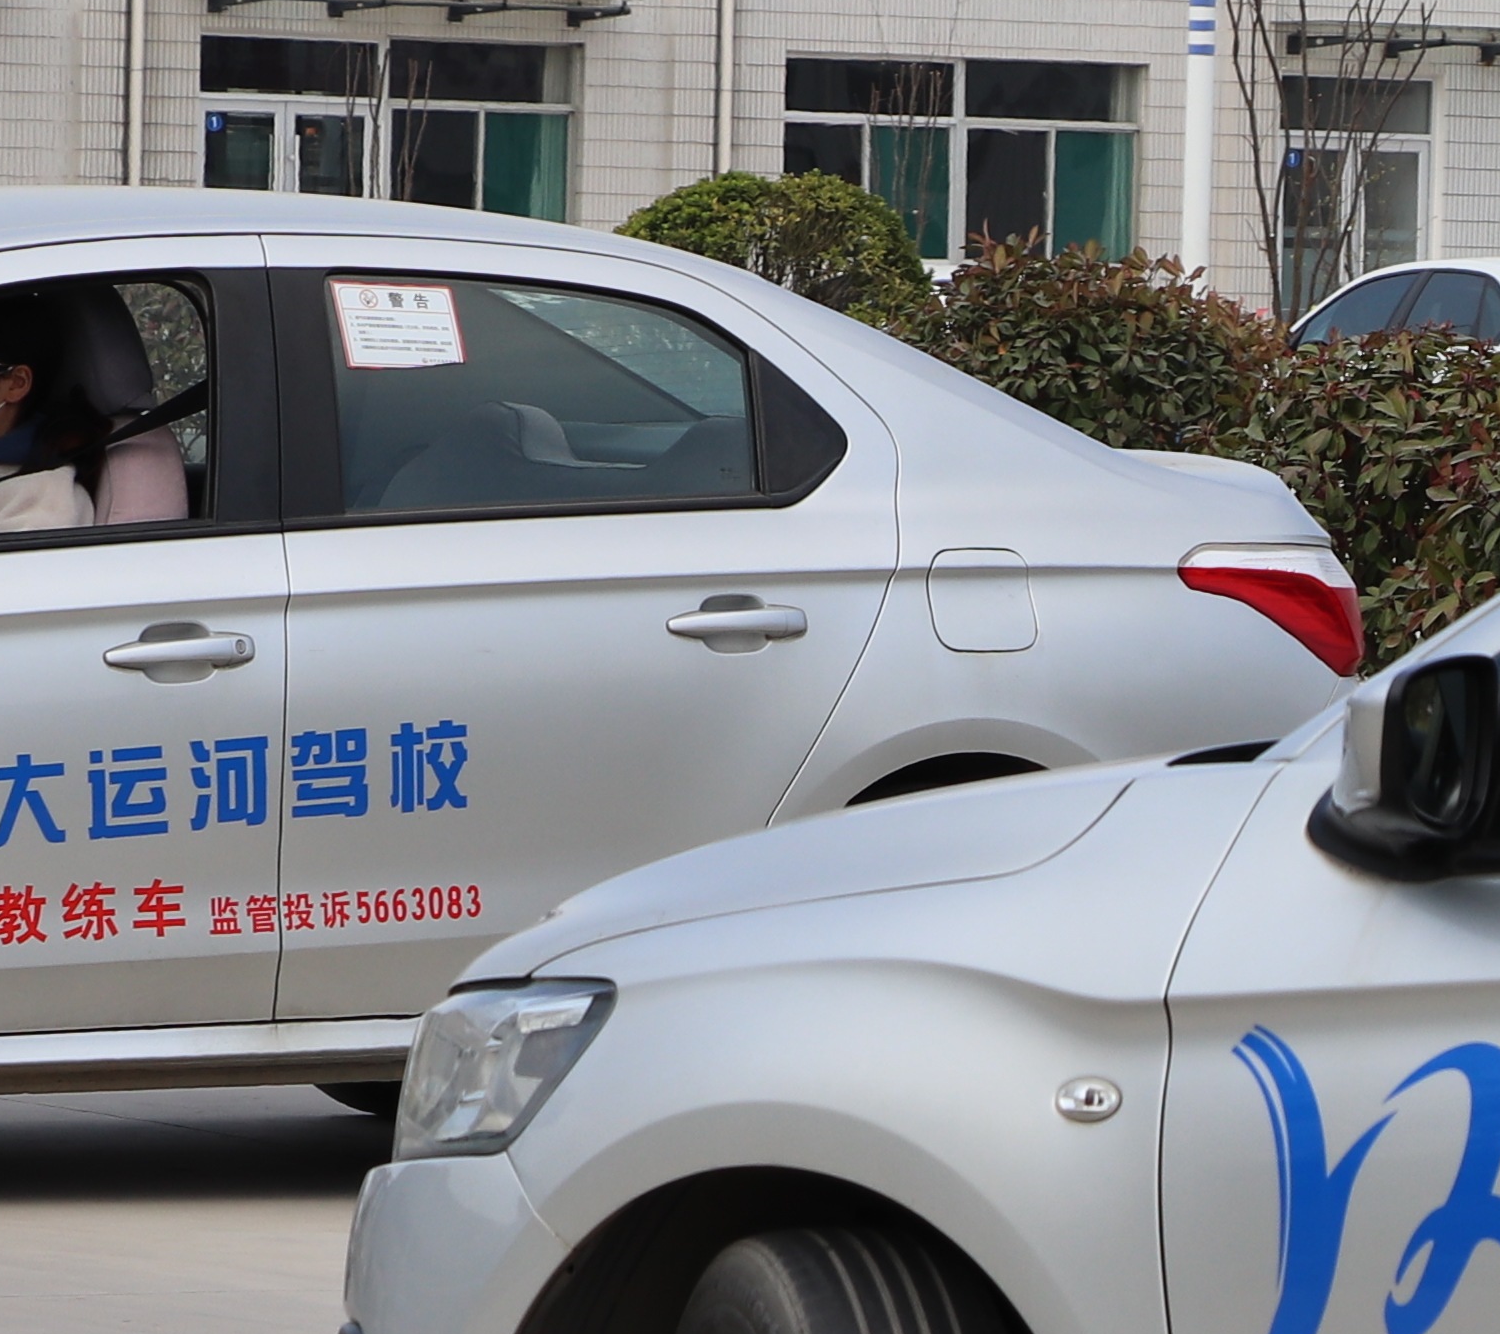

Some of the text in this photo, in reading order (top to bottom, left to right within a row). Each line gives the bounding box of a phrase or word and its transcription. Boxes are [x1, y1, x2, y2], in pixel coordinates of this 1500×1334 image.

[387, 291, 430, 310] 警告
[209, 883, 483, 937] 监管投诉5663083
